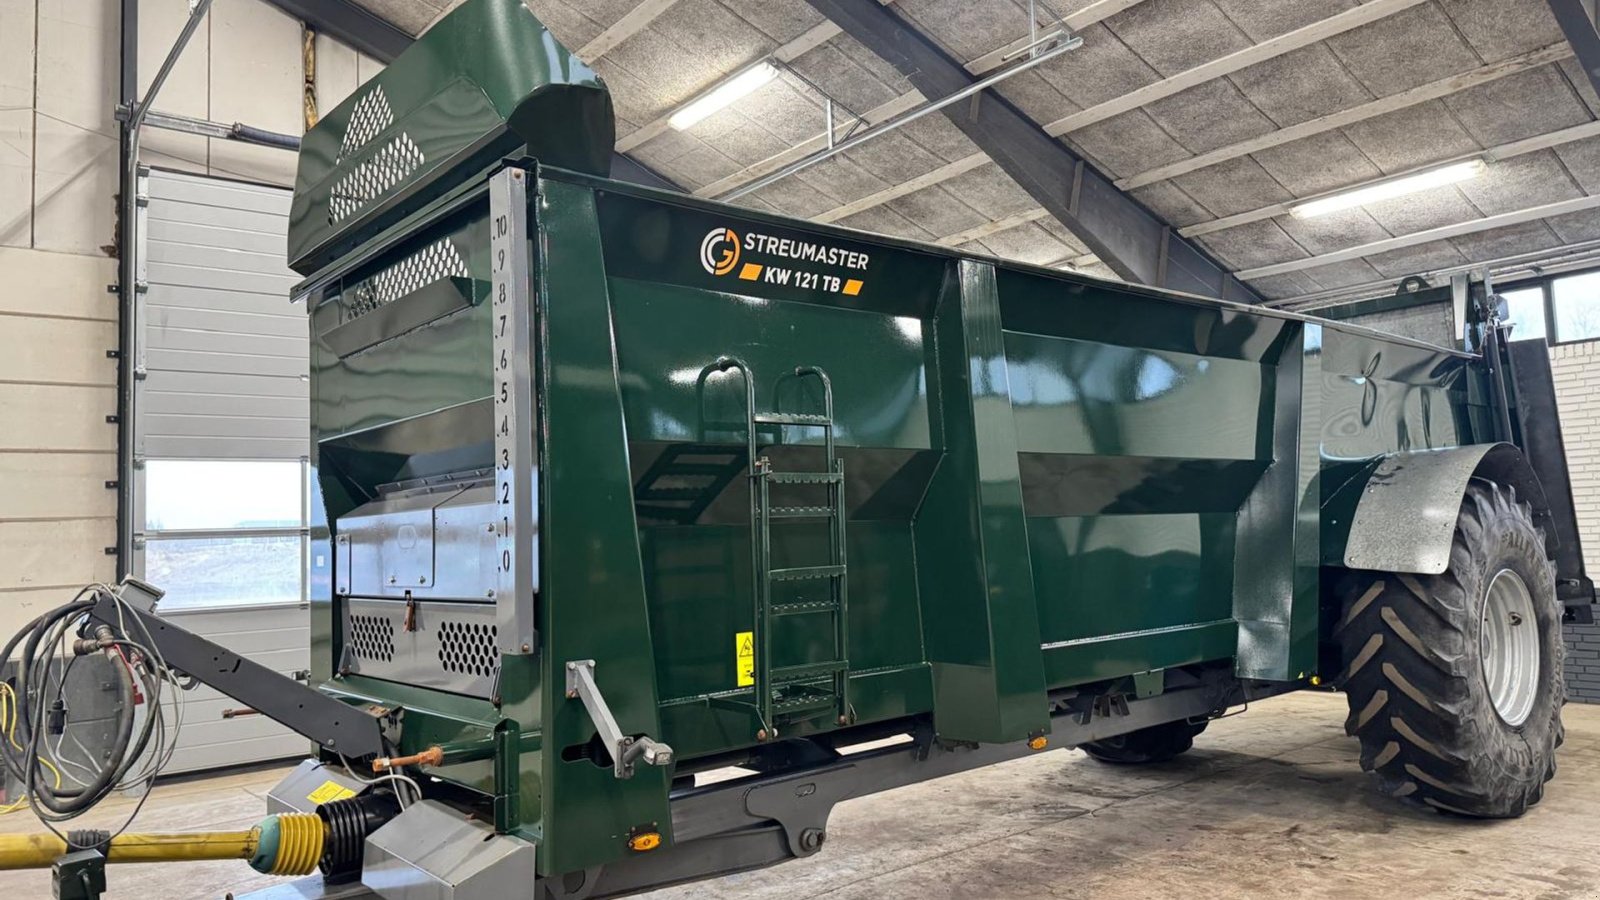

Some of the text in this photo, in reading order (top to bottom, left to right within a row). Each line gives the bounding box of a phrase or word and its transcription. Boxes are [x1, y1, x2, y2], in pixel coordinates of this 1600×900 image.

[743, 232, 870, 270] STREUMASTER
[764, 266, 841, 293] KW 121 TB
